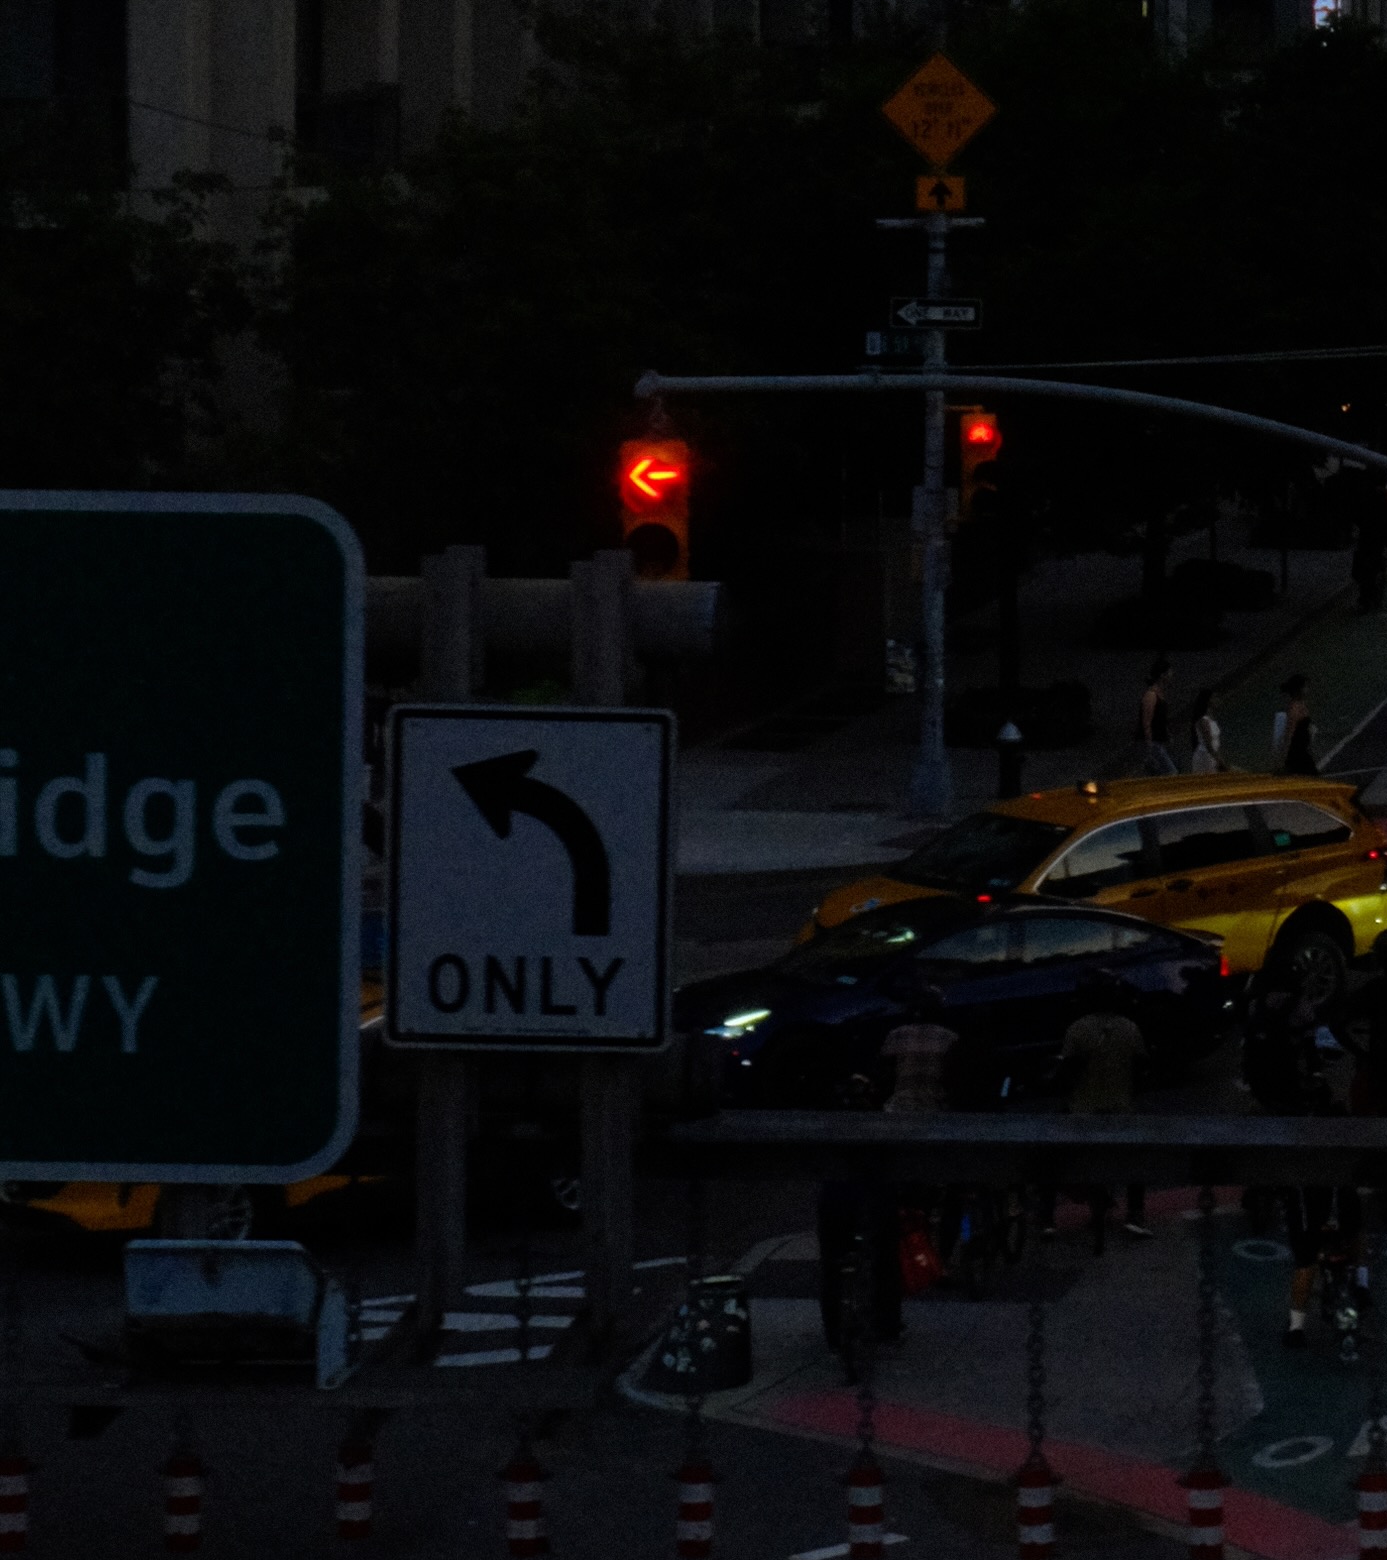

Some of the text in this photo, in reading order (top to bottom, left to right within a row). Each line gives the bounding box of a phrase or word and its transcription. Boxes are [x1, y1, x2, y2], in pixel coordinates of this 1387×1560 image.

[905, 308, 968, 318] ONE WAY
[428, 952, 625, 1017] ONLY
